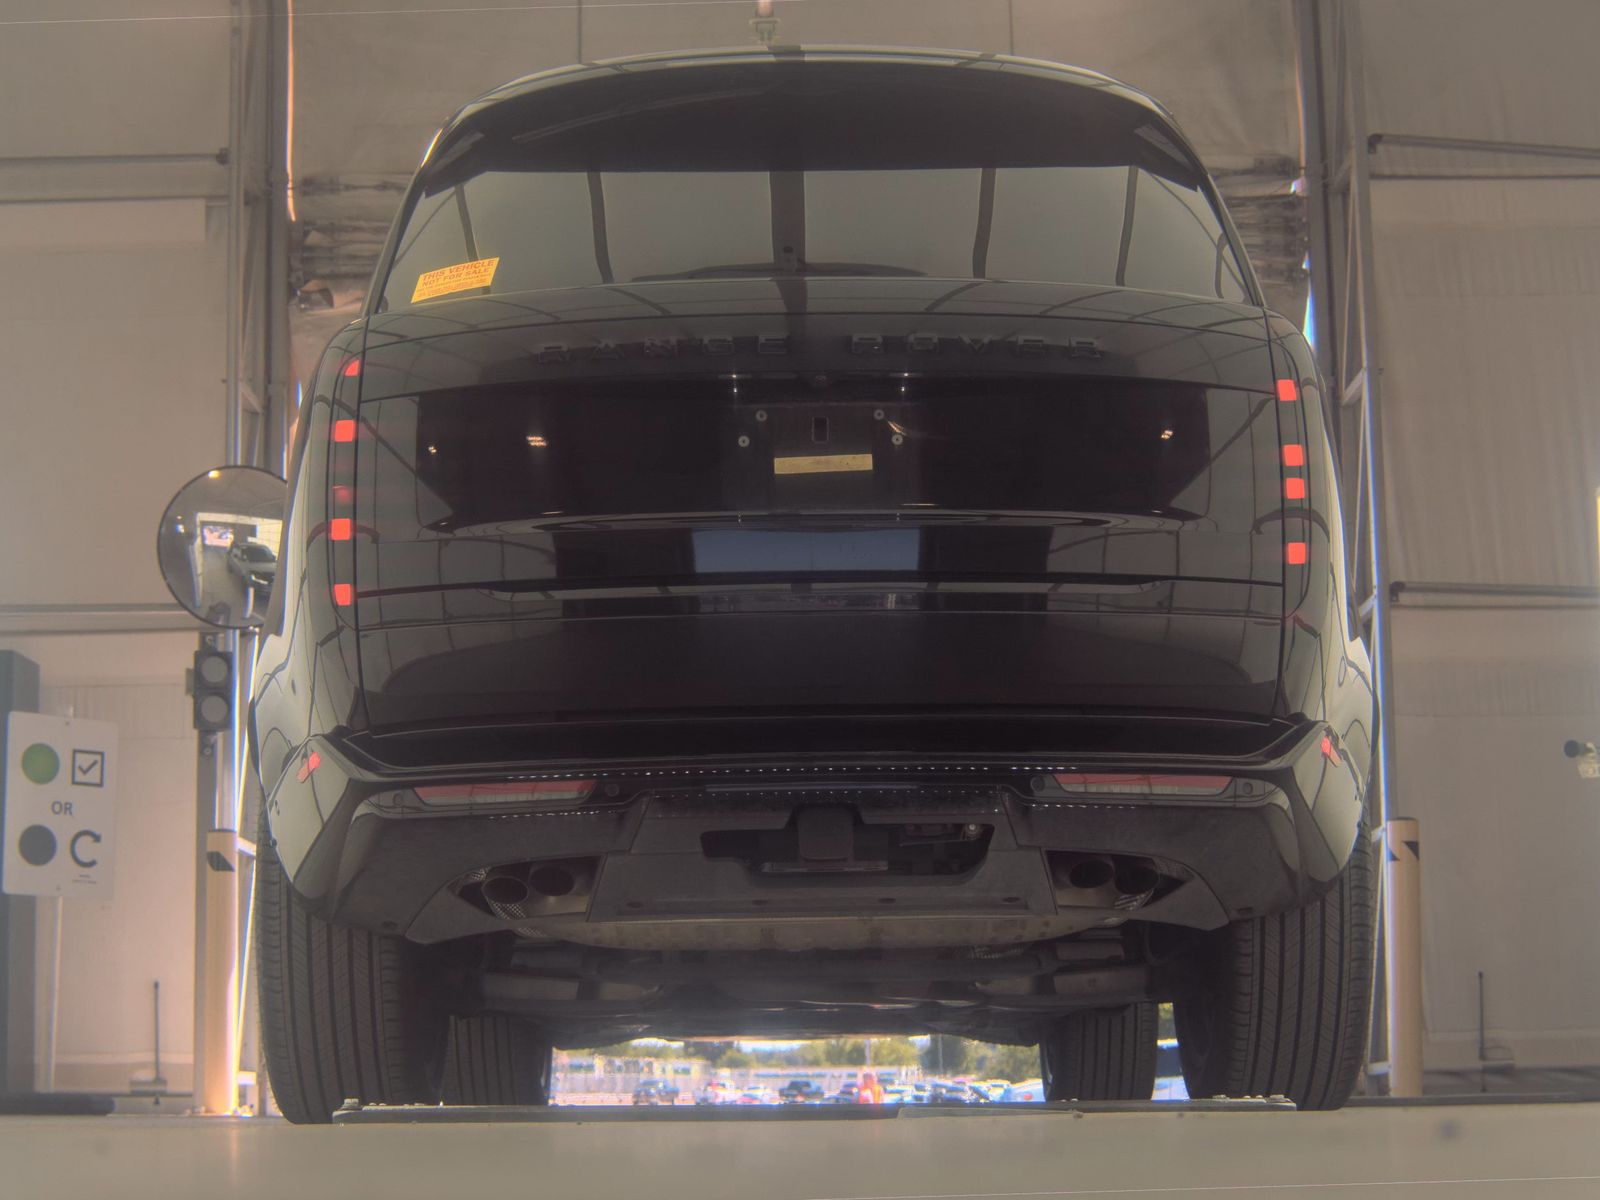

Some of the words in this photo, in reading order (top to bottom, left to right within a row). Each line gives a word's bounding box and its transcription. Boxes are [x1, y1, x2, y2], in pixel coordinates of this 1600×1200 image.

[422, 278, 440, 288] NOT
[443, 273, 462, 282] FOR
[465, 267, 489, 276] SALE
[423, 270, 446, 281] THIS
[449, 260, 494, 273] VEHICLE
[852, 333, 1104, 360] ROVER
[51, 801, 73, 816] OR
